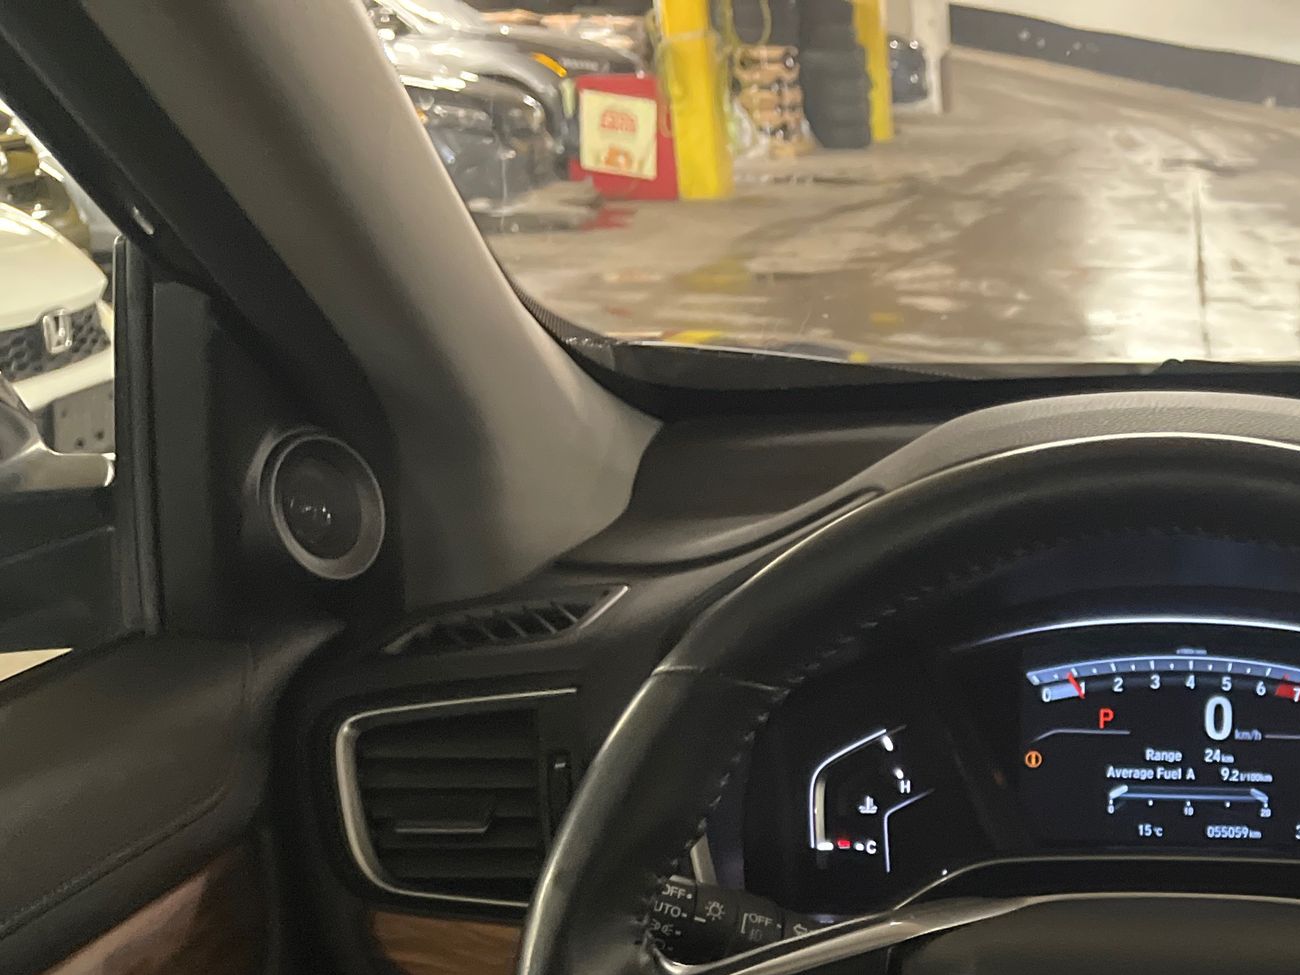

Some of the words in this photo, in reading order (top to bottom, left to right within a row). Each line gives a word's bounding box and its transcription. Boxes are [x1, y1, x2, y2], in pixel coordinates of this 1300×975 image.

[1113, 677, 1124, 692] 2
[1150, 675, 1160, 689] 3
[1185, 675, 1196, 689] 4
[1221, 676, 1232, 691] 5
[1256, 681, 1266, 696] 6
[1100, 708, 1114, 729] P
[1204, 696, 1233, 741] 0
[1234, 729, 1262, 741] km/h
[1145, 749, 1182, 762] Range
[1106, 766, 1154, 779] Average
[1156, 767, 1182, 779] Fuel
[1186, 768, 1196, 780] A
[900, 780, 911, 794] H
[866, 840, 876, 855] C
[653, 900, 681, 918] UTO
[748, 913, 773, 926] OFF
